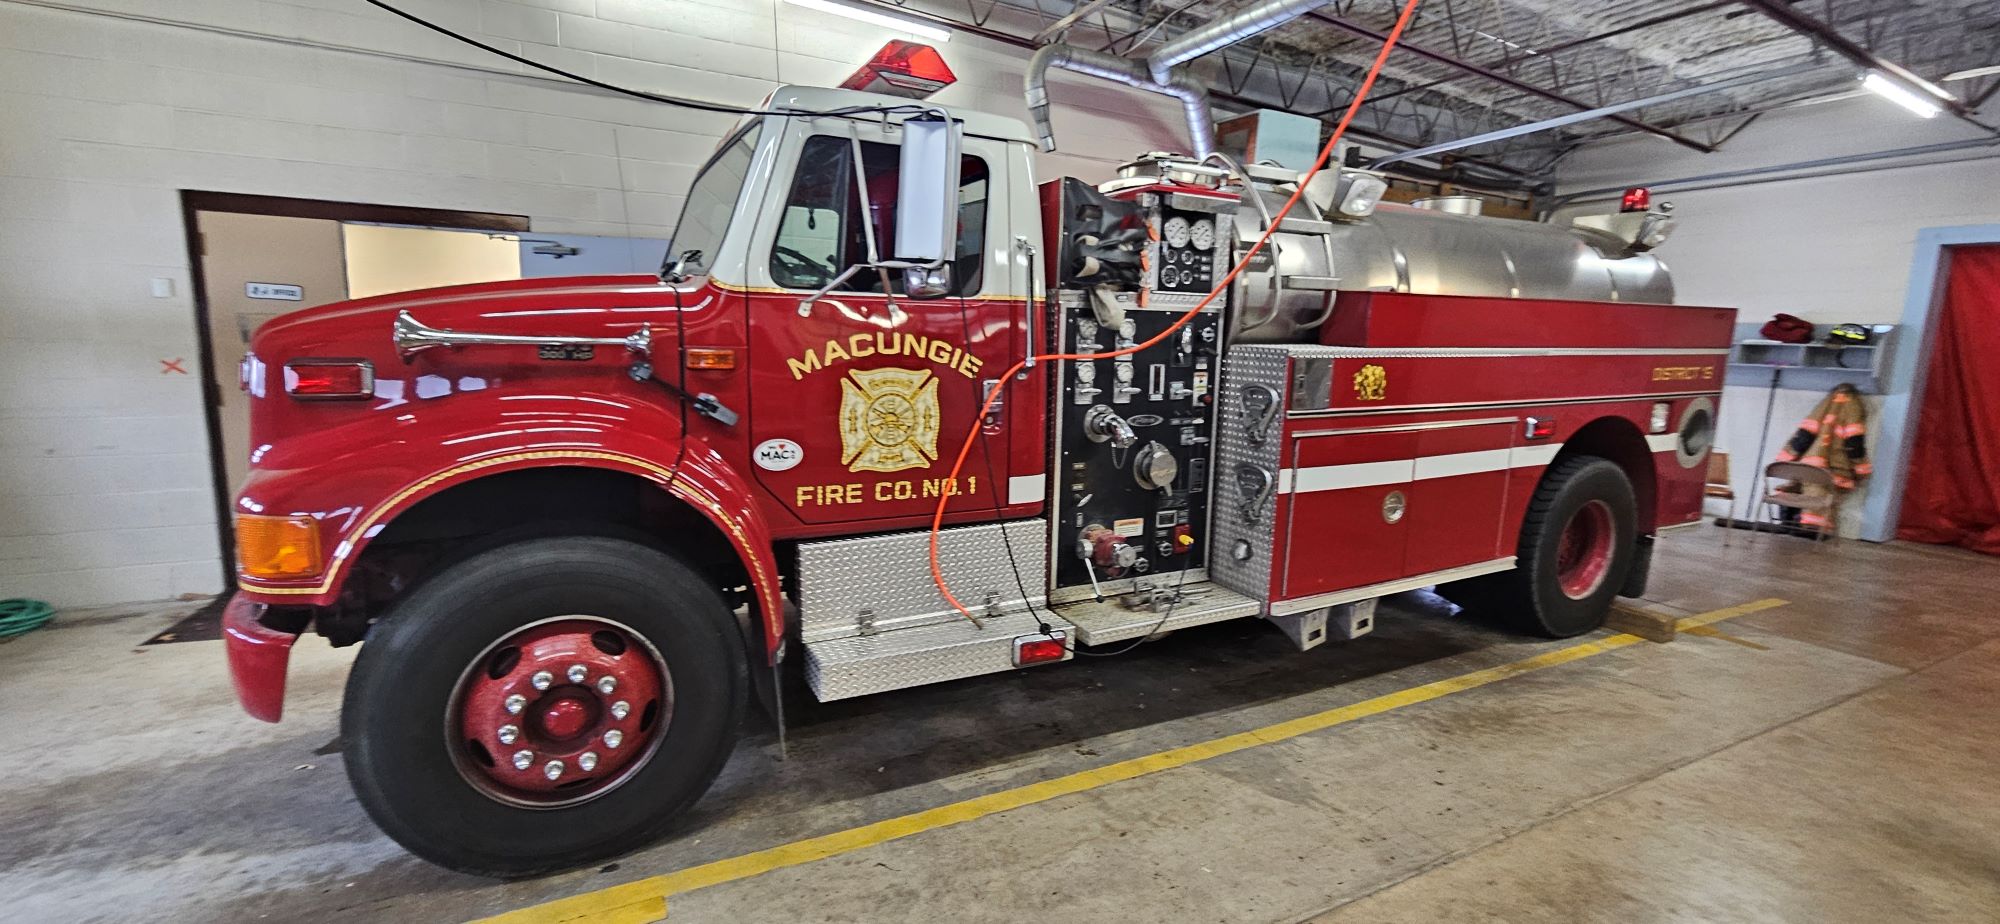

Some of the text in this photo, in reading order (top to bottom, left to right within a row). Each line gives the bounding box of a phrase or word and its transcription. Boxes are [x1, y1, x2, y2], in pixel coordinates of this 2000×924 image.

[786, 331, 984, 381] MACUNGIE
[1652, 366, 1701, 381] DISTRICT
[761, 450, 789, 461] MAC
[796, 476, 977, 507] FIRE CO. NO. 1
